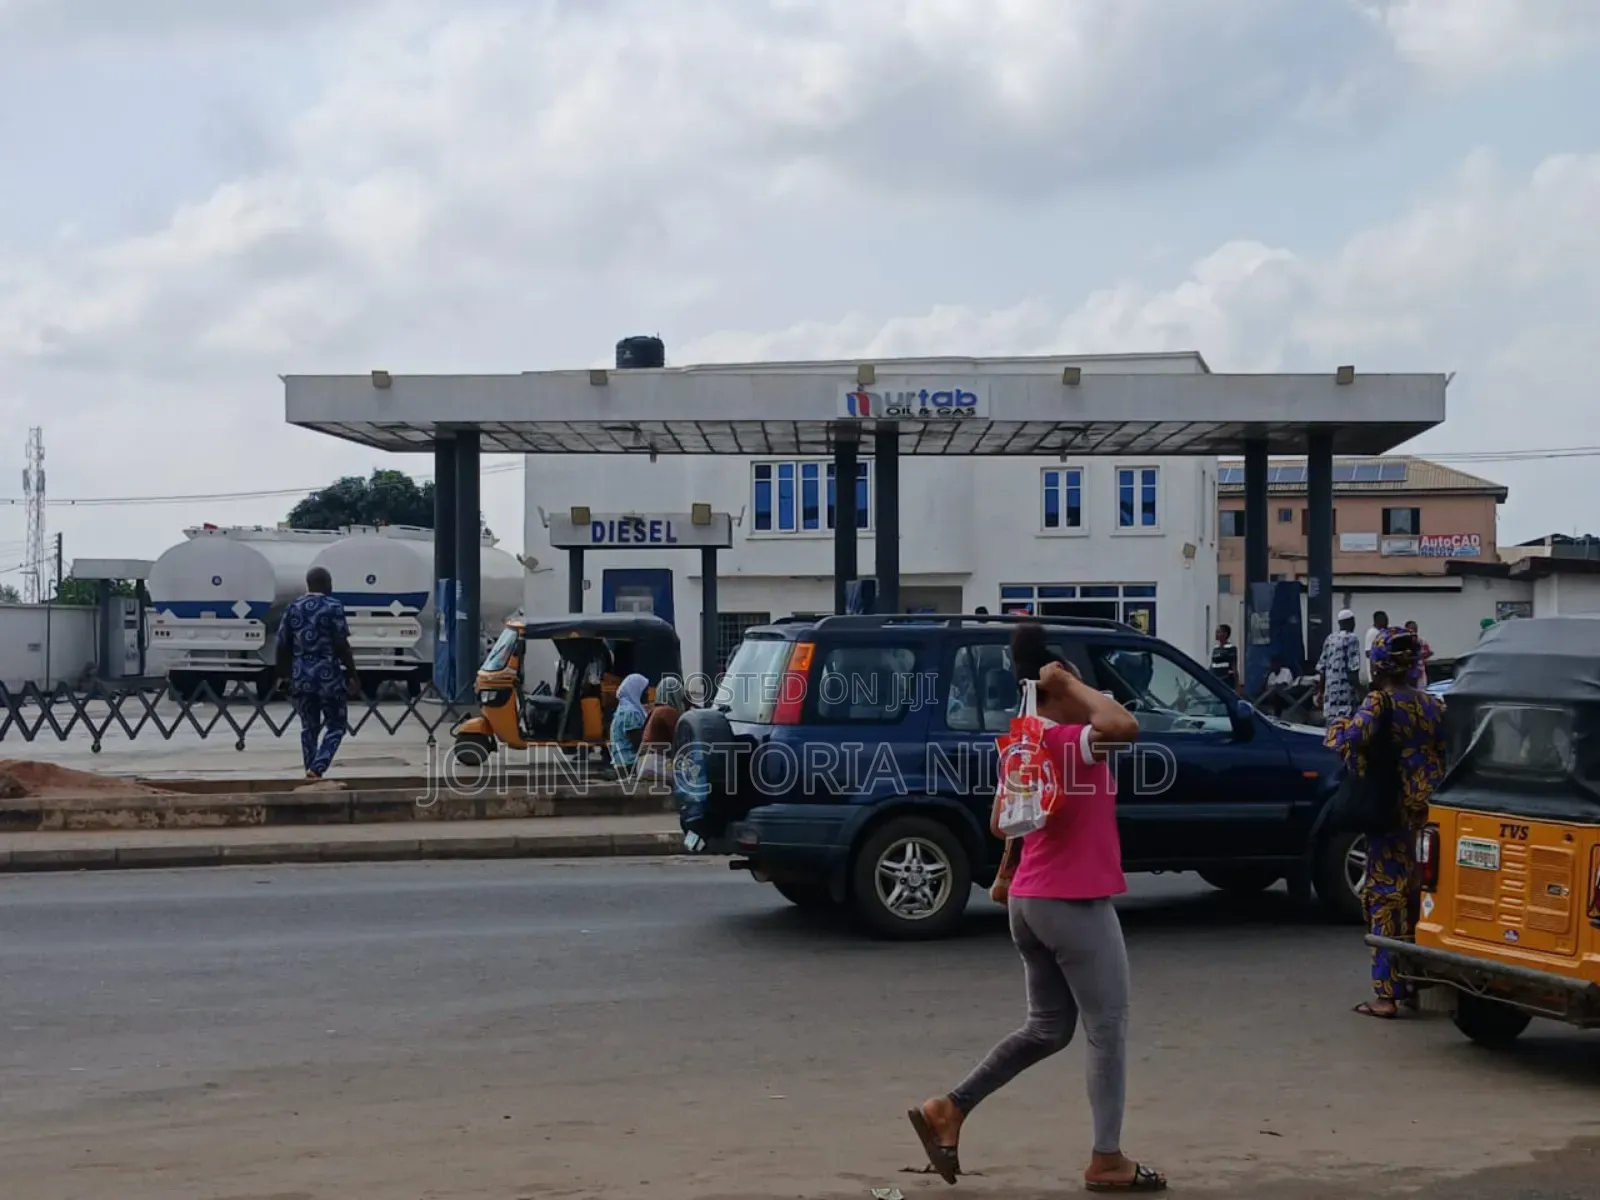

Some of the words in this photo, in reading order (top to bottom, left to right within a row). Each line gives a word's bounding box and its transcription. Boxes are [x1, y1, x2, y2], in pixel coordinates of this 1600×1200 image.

[886, 407, 914, 416] OIL
[919, 407, 932, 416] &
[937, 407, 976, 416] GAS
[591, 520, 678, 543] DIESEL
[1420, 534, 1480, 548] AutoCAD
[1499, 824, 1530, 841] TVS
